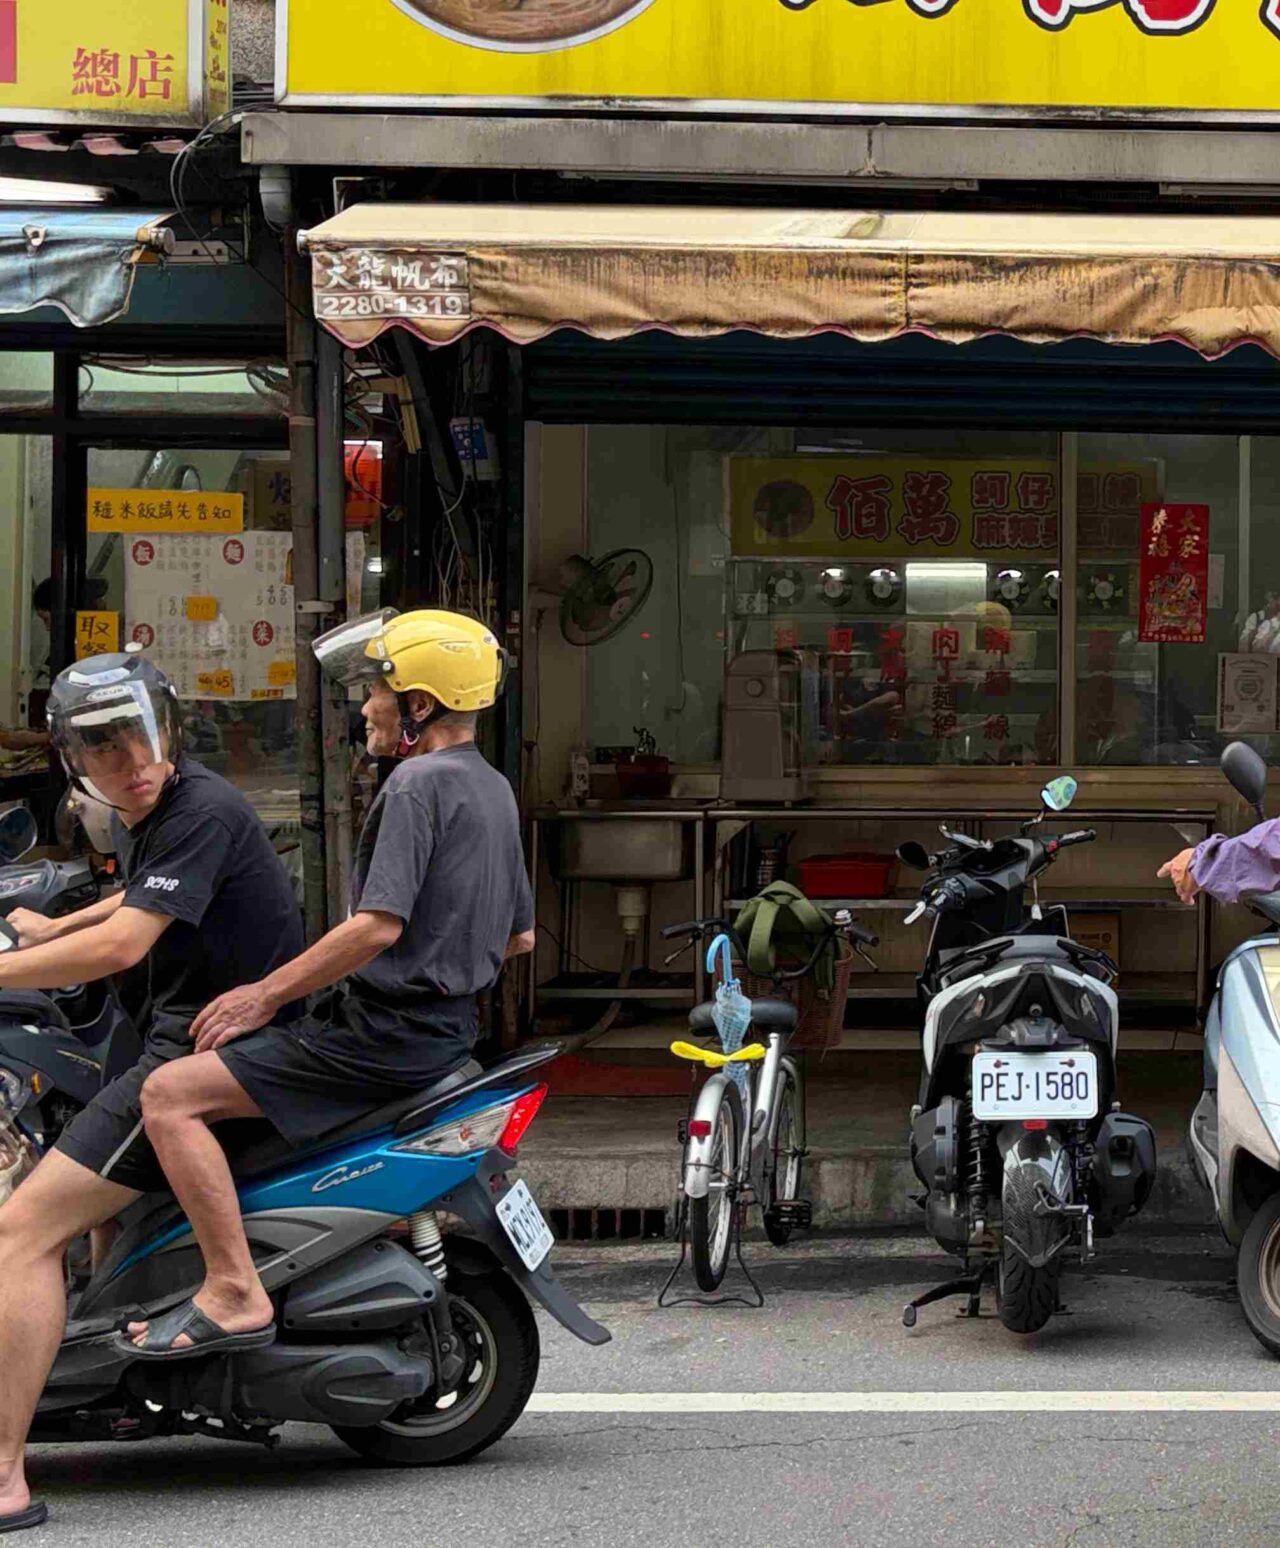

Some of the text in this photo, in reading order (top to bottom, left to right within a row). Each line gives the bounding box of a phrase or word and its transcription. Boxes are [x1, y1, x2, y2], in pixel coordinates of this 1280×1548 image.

[71, 47, 175, 100] 總店
[322, 294, 464, 315] 2280-1319
[826, 470, 960, 546] 佰萬
